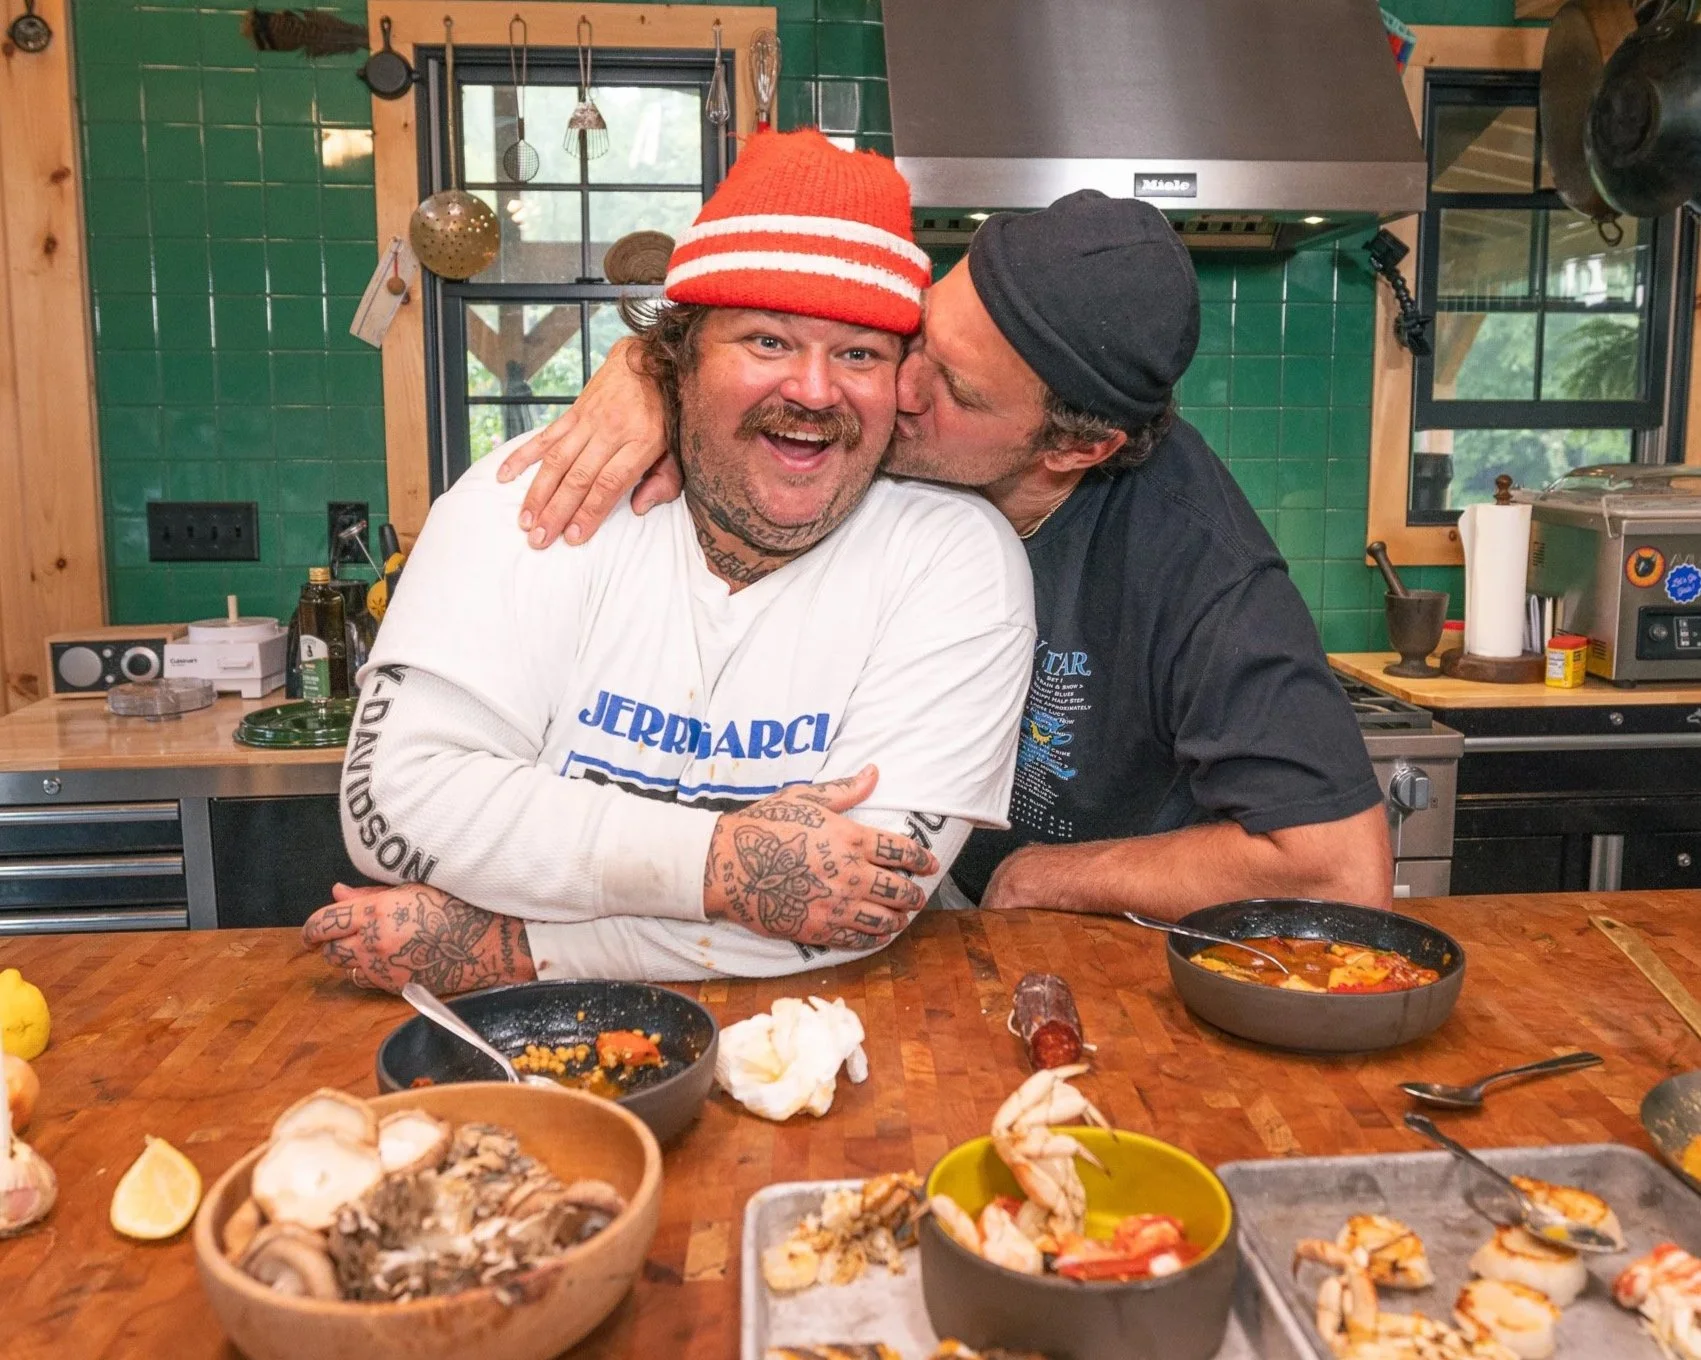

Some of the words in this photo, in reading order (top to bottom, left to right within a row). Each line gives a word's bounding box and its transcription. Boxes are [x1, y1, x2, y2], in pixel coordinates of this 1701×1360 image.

[1042, 650, 1092, 677] TAR
[1044, 700, 1092, 711] APPROXIMATELY
[1051, 747, 1072, 757] CRIME
